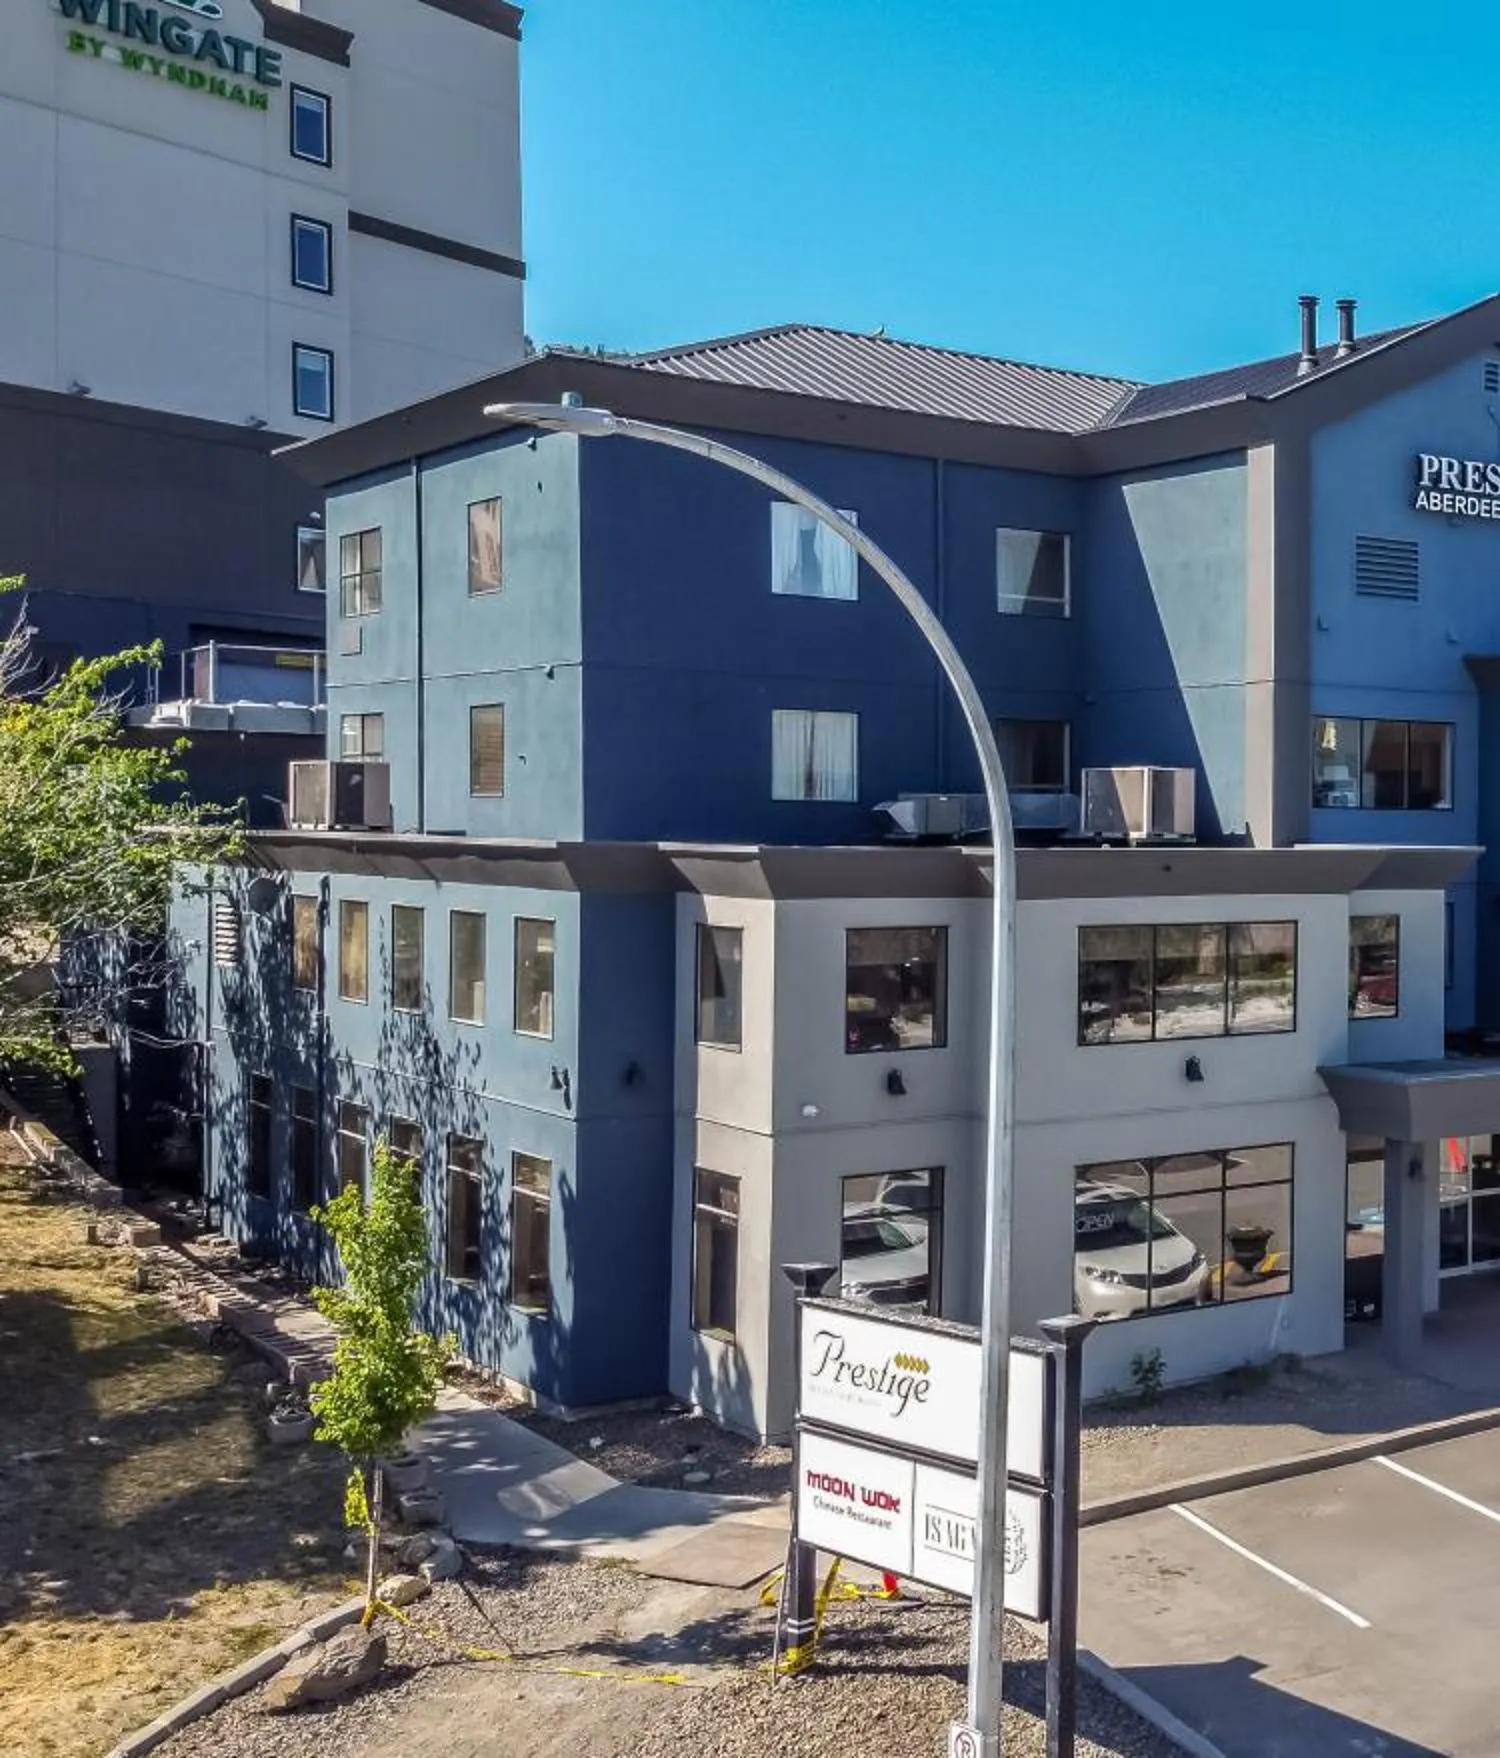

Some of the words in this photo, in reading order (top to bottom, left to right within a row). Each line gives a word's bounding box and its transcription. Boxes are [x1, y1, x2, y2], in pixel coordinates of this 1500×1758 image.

[58, 0, 283, 87] WINGATE
[67, 30, 106, 58] BY
[119, 46, 269, 111] WYNDHAM
[809, 1330, 931, 1418] Prestige
[806, 1469, 855, 1502] MOON
[861, 1486, 901, 1513] WOK
